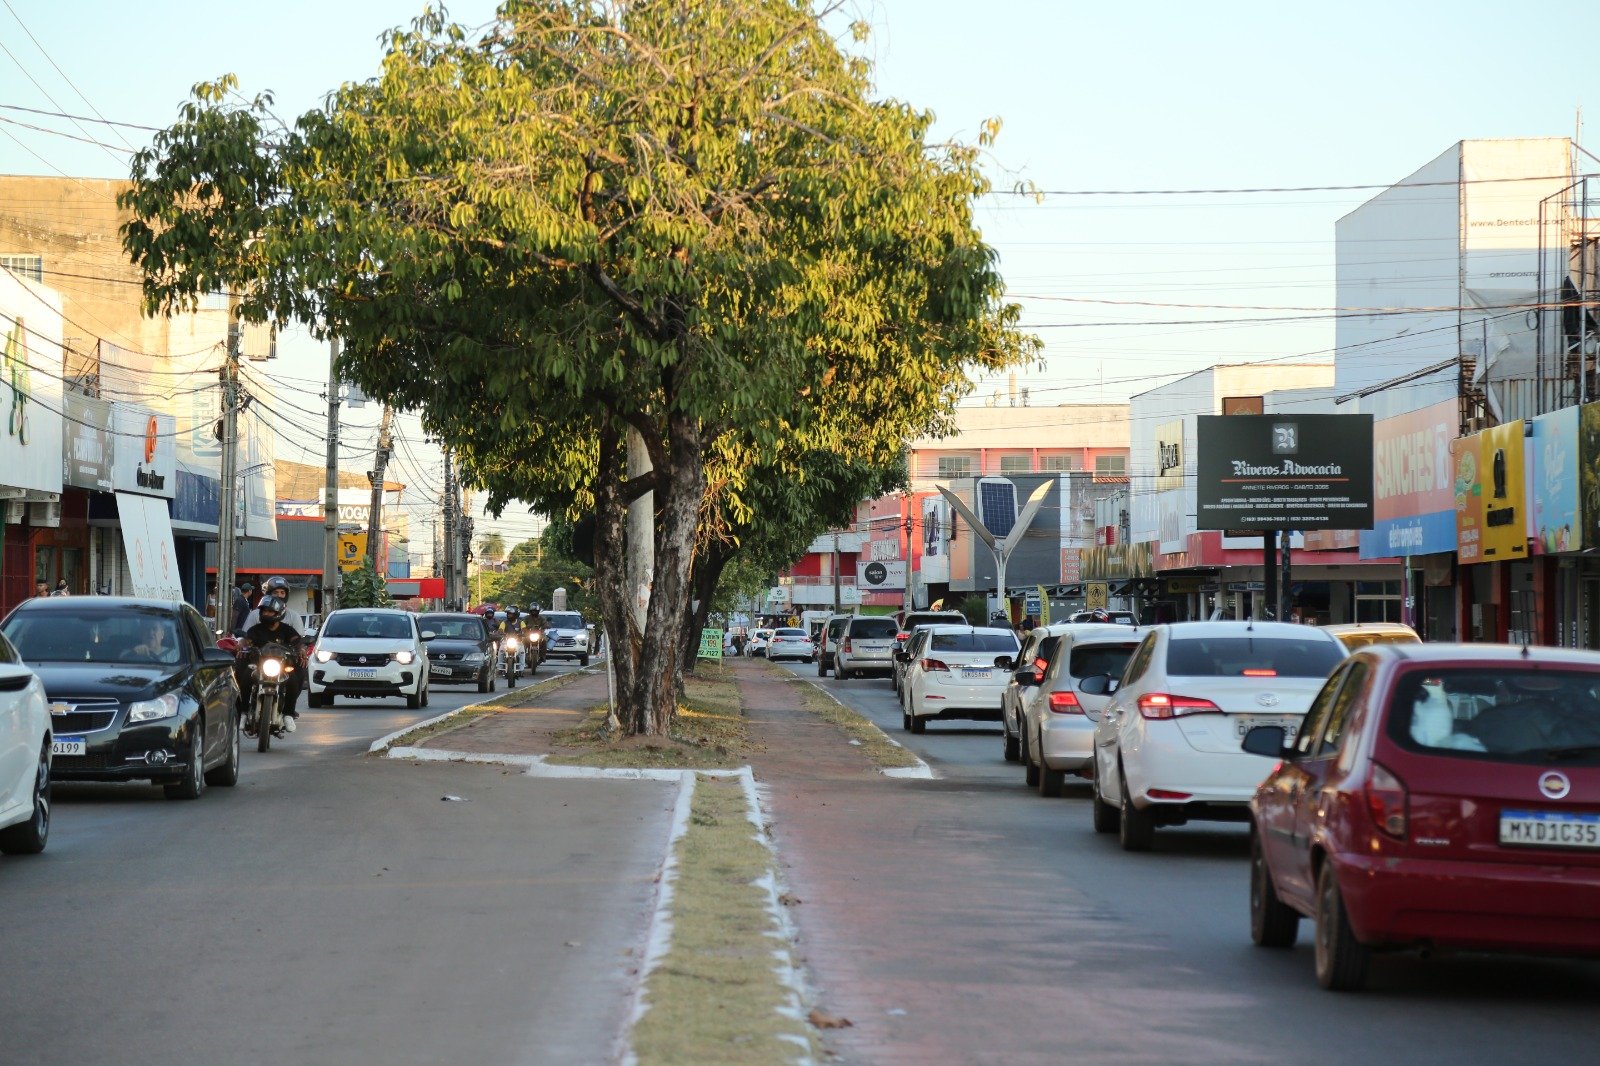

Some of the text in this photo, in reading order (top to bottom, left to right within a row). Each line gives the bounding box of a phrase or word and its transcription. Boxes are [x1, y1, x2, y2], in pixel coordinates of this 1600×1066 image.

[1231, 460, 1342, 476] Riveros Advocacia
[1376, 429, 1434, 499] SANCHES
[1510, 822, 1597, 842] MXD1C35
